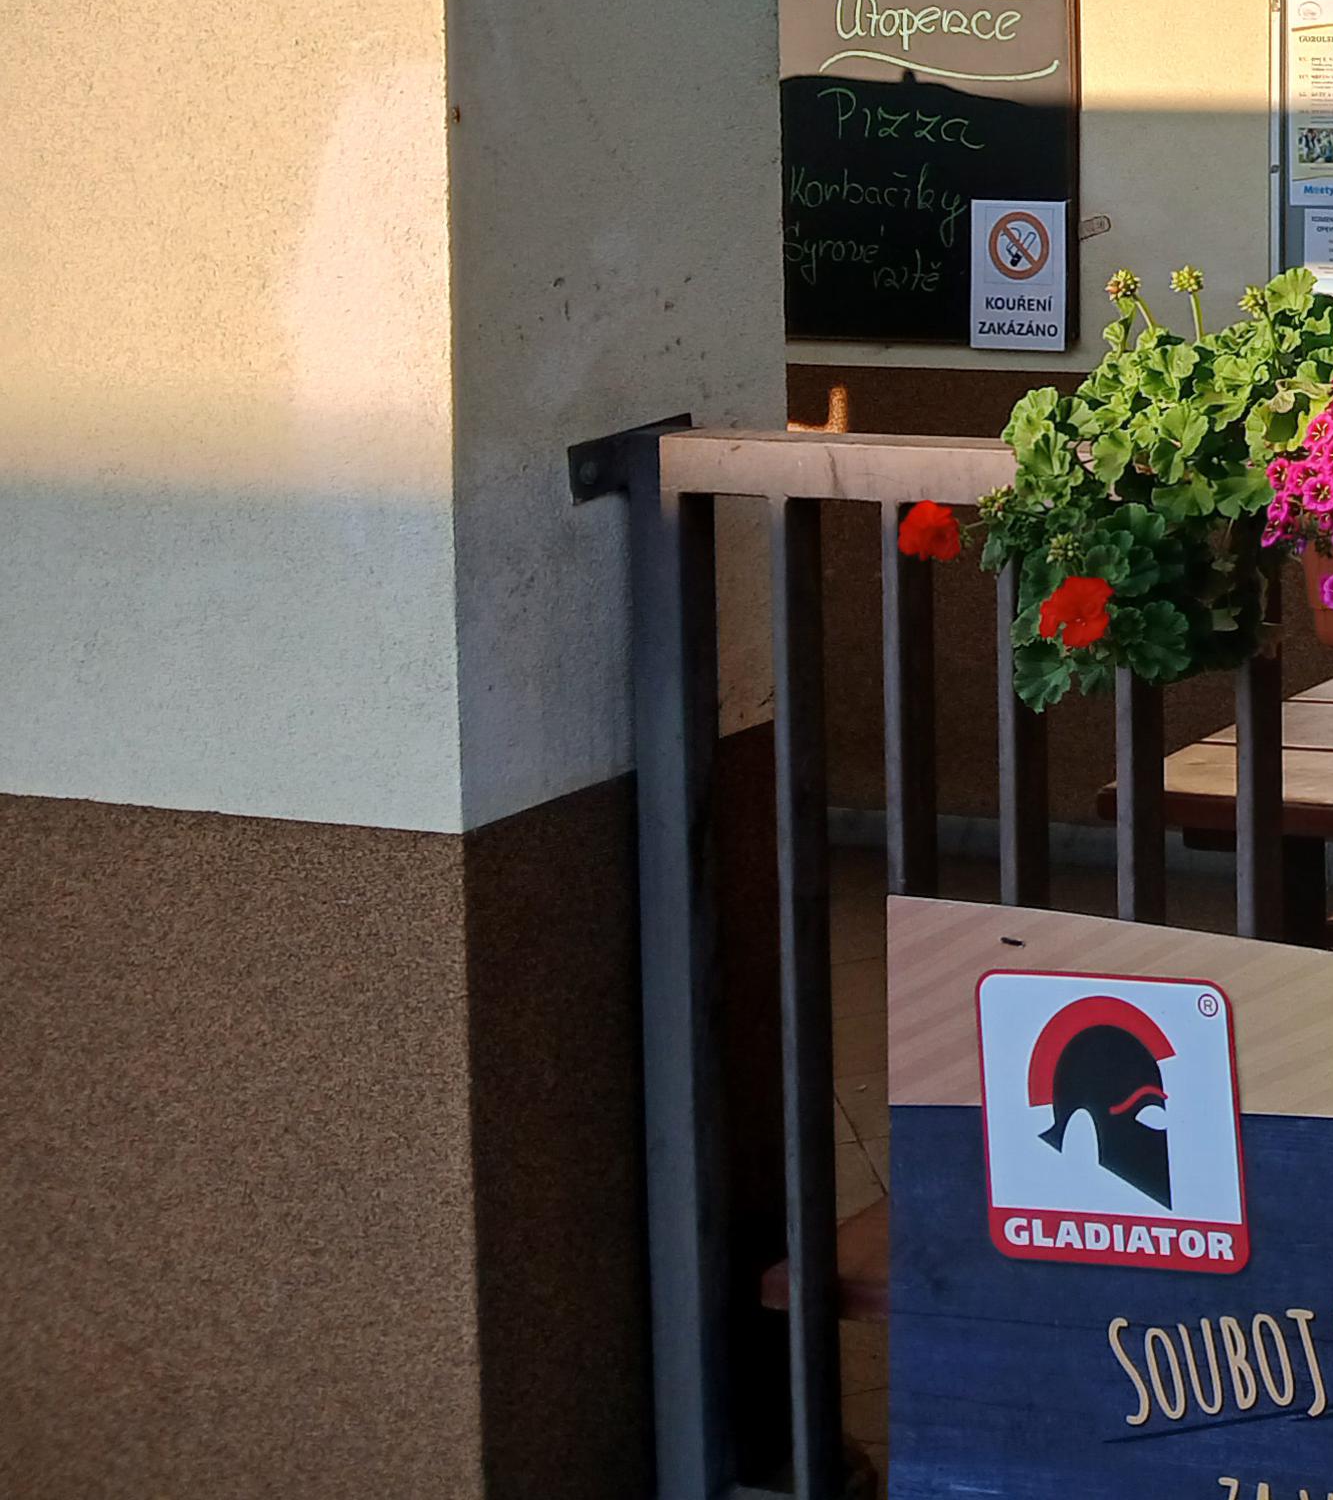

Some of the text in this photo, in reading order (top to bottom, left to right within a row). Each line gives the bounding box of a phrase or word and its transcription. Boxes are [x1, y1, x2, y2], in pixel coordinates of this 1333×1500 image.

[817, 87, 984, 149] Pizza
[984, 293, 1053, 314] KOUŘENÍ
[977, 318, 1059, 339] ZAKÁZÁNO
[1002, 1215, 1236, 1263] GLADIATOR
[1106, 1307, 1328, 1427] SOUBOJ
